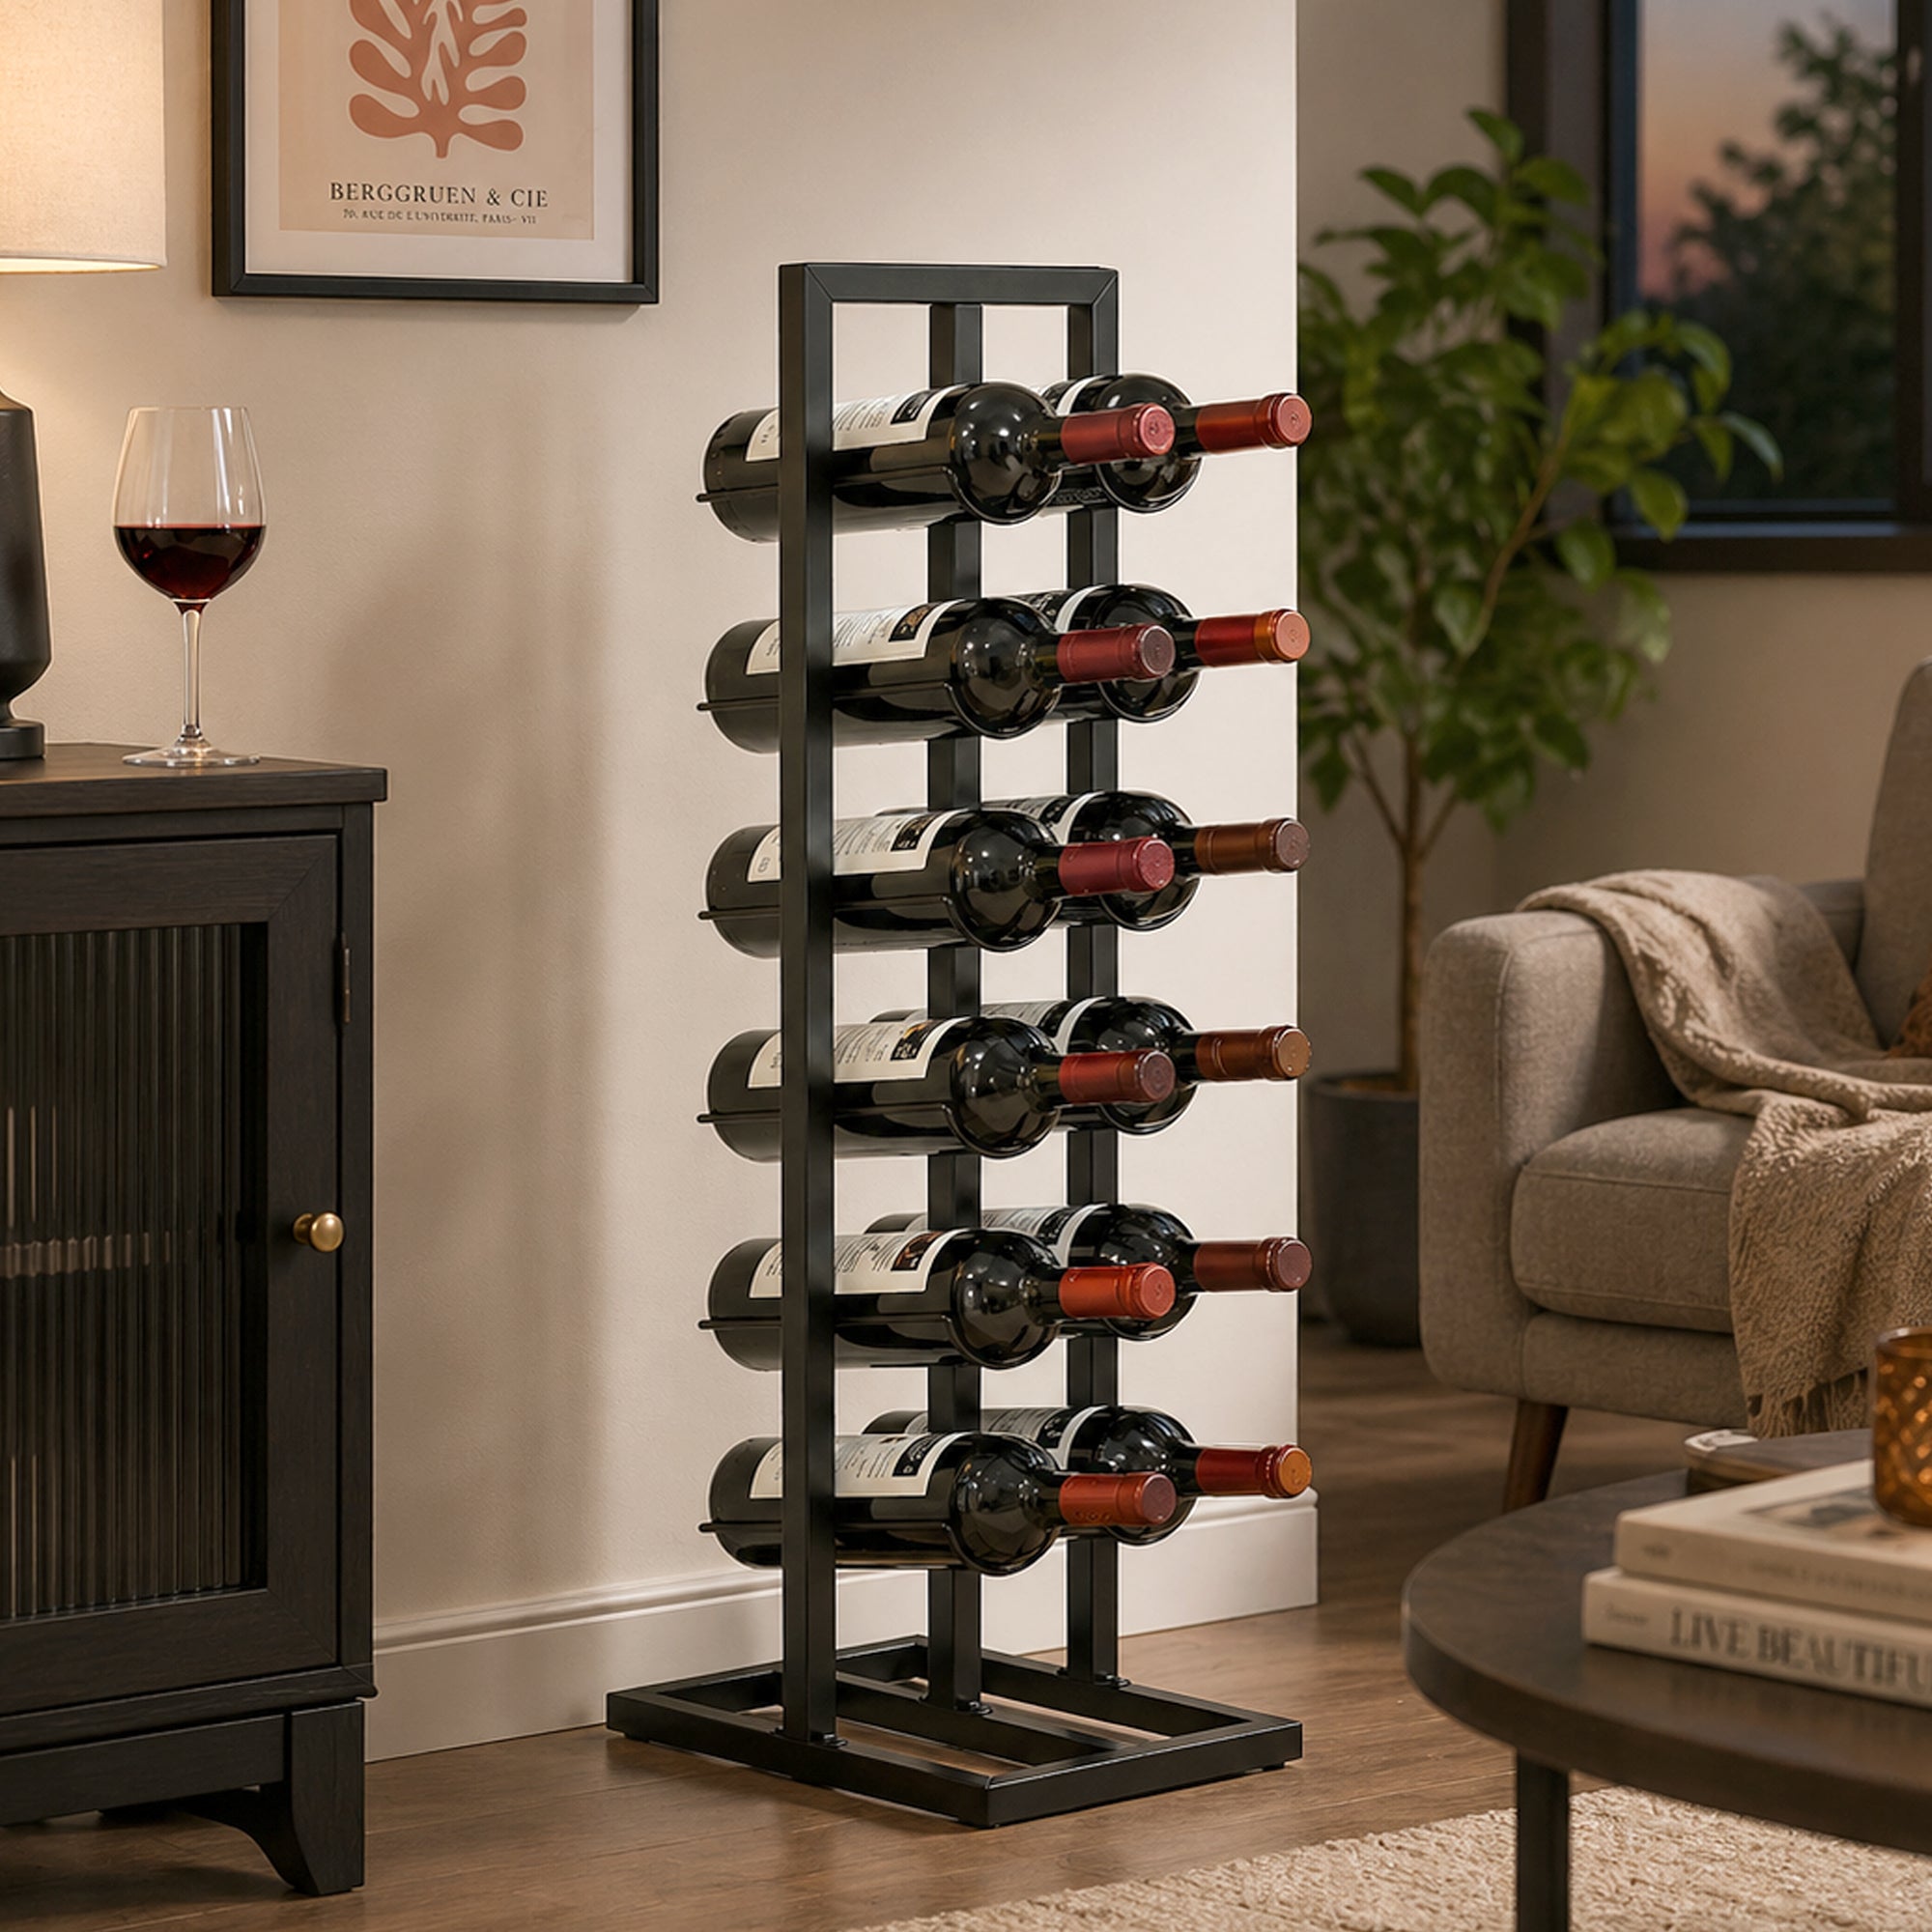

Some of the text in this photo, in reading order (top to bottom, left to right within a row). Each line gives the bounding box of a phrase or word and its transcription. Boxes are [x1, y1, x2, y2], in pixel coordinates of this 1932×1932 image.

[330, 183, 549, 208] BERGGRUEN & CIE
[1669, 1605, 1750, 1658] LIVE
